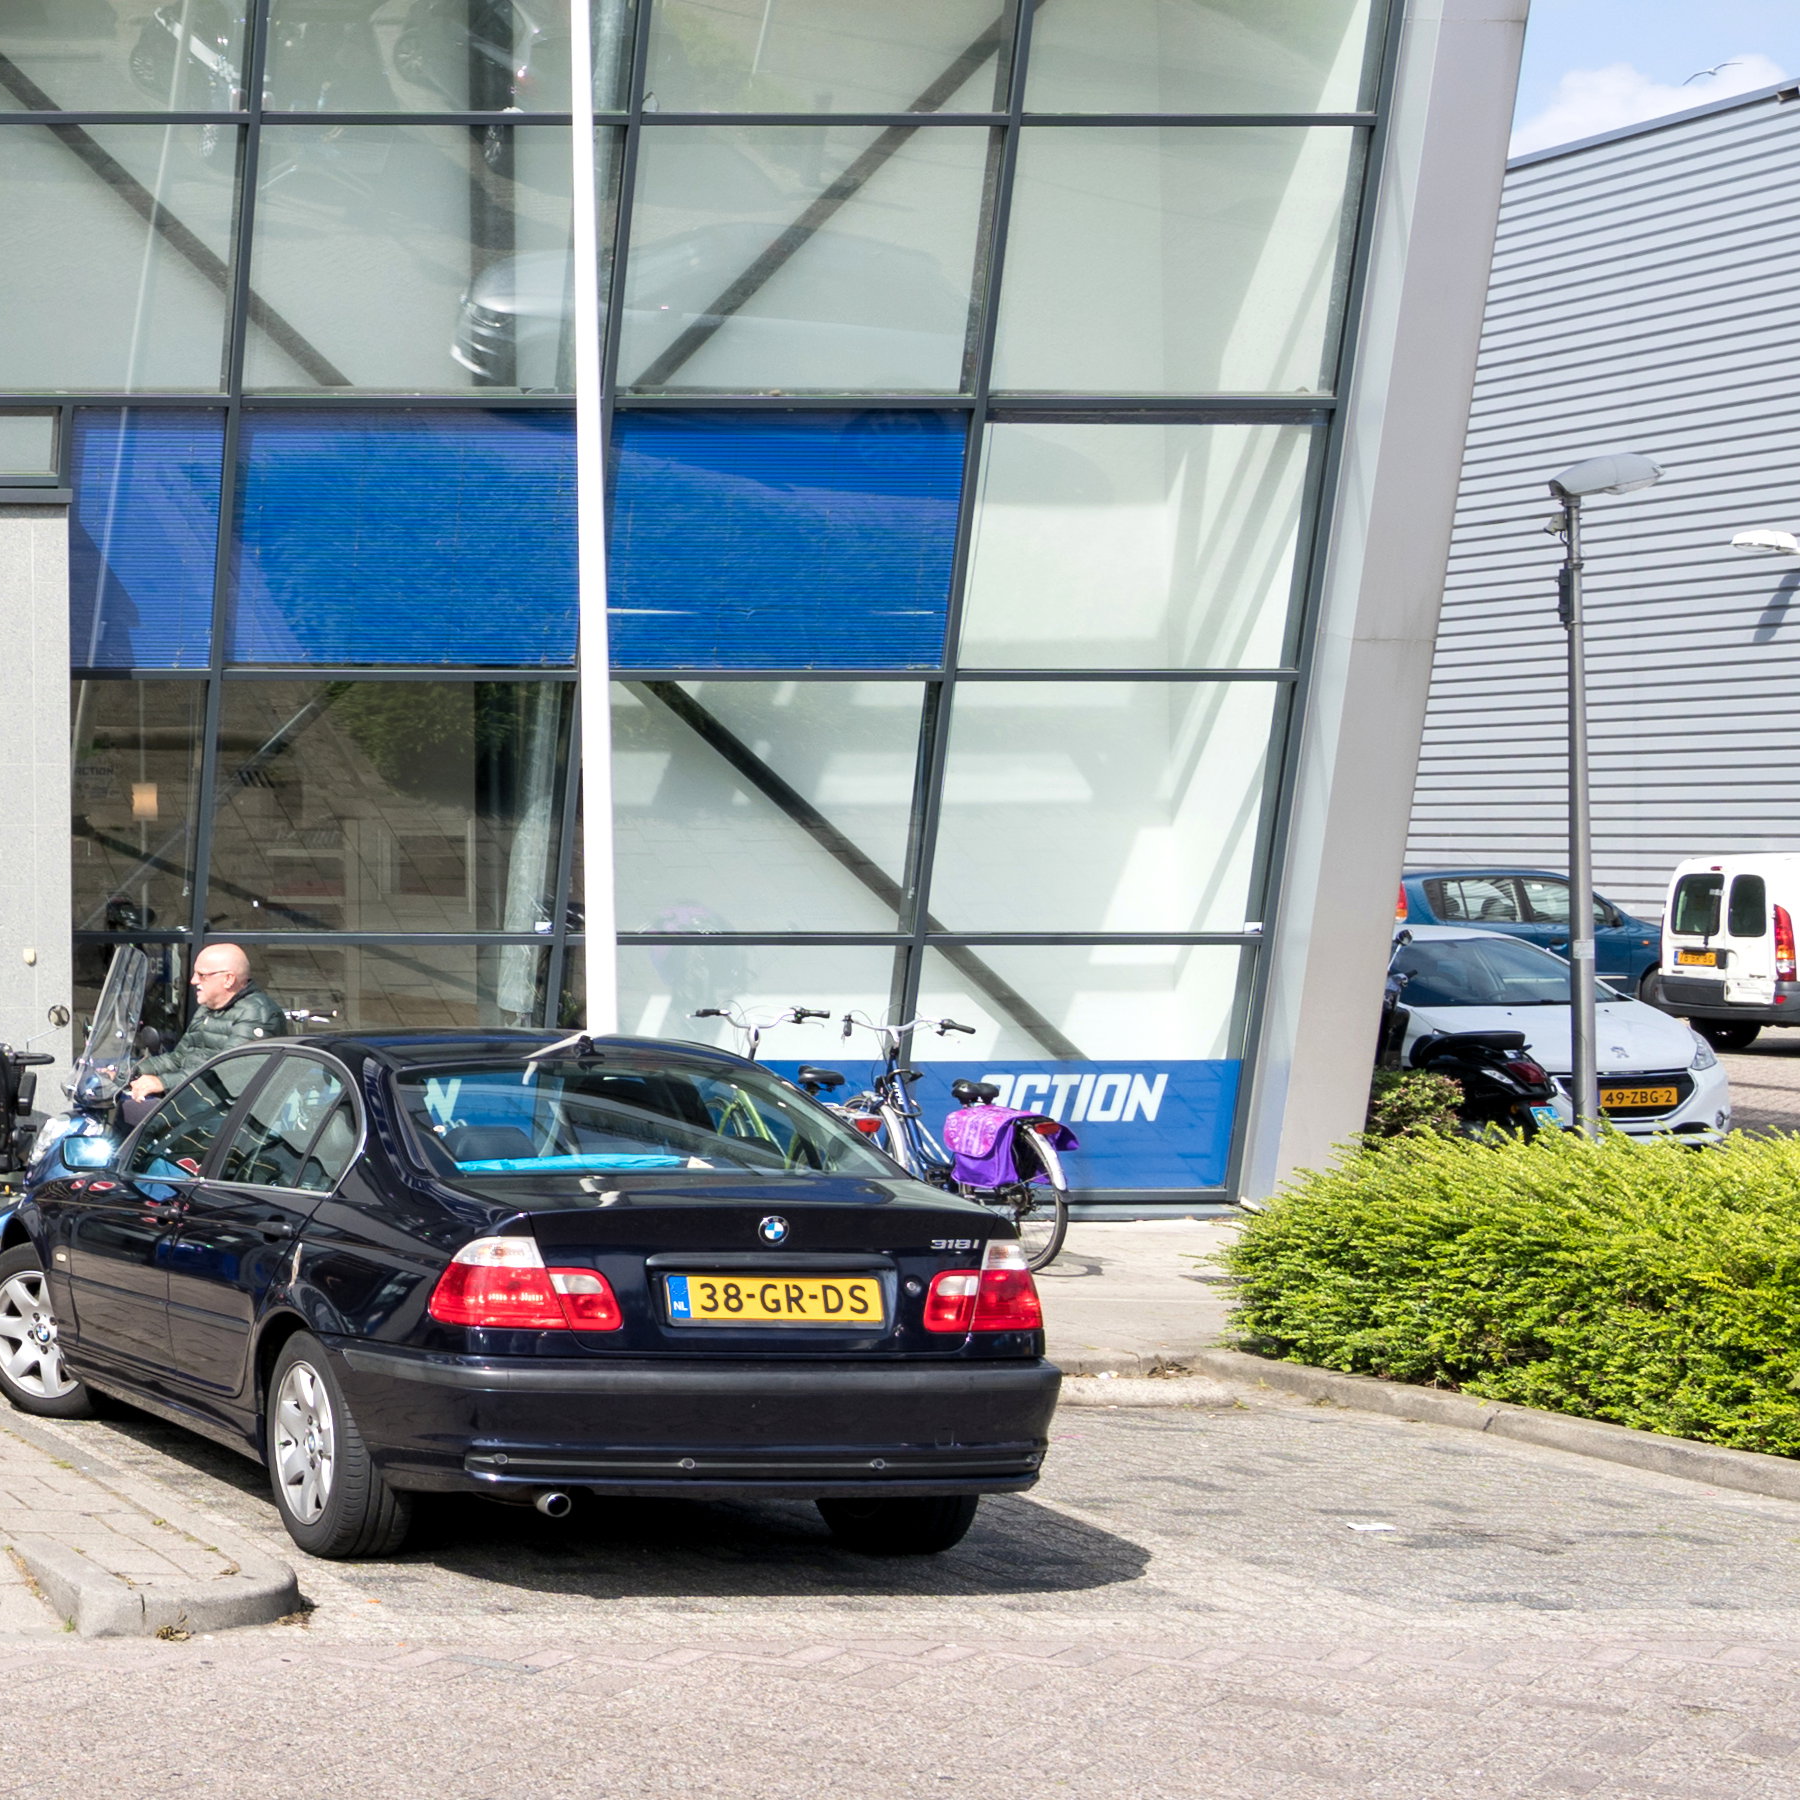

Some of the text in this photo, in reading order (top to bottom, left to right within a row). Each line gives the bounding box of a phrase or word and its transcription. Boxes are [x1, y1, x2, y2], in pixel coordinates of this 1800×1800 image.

[1604, 1089, 1673, 1105] 49-ZBG-2
[673, 1301, 689, 1312] NL
[699, 1282, 870, 1315] 38-GR-DS
